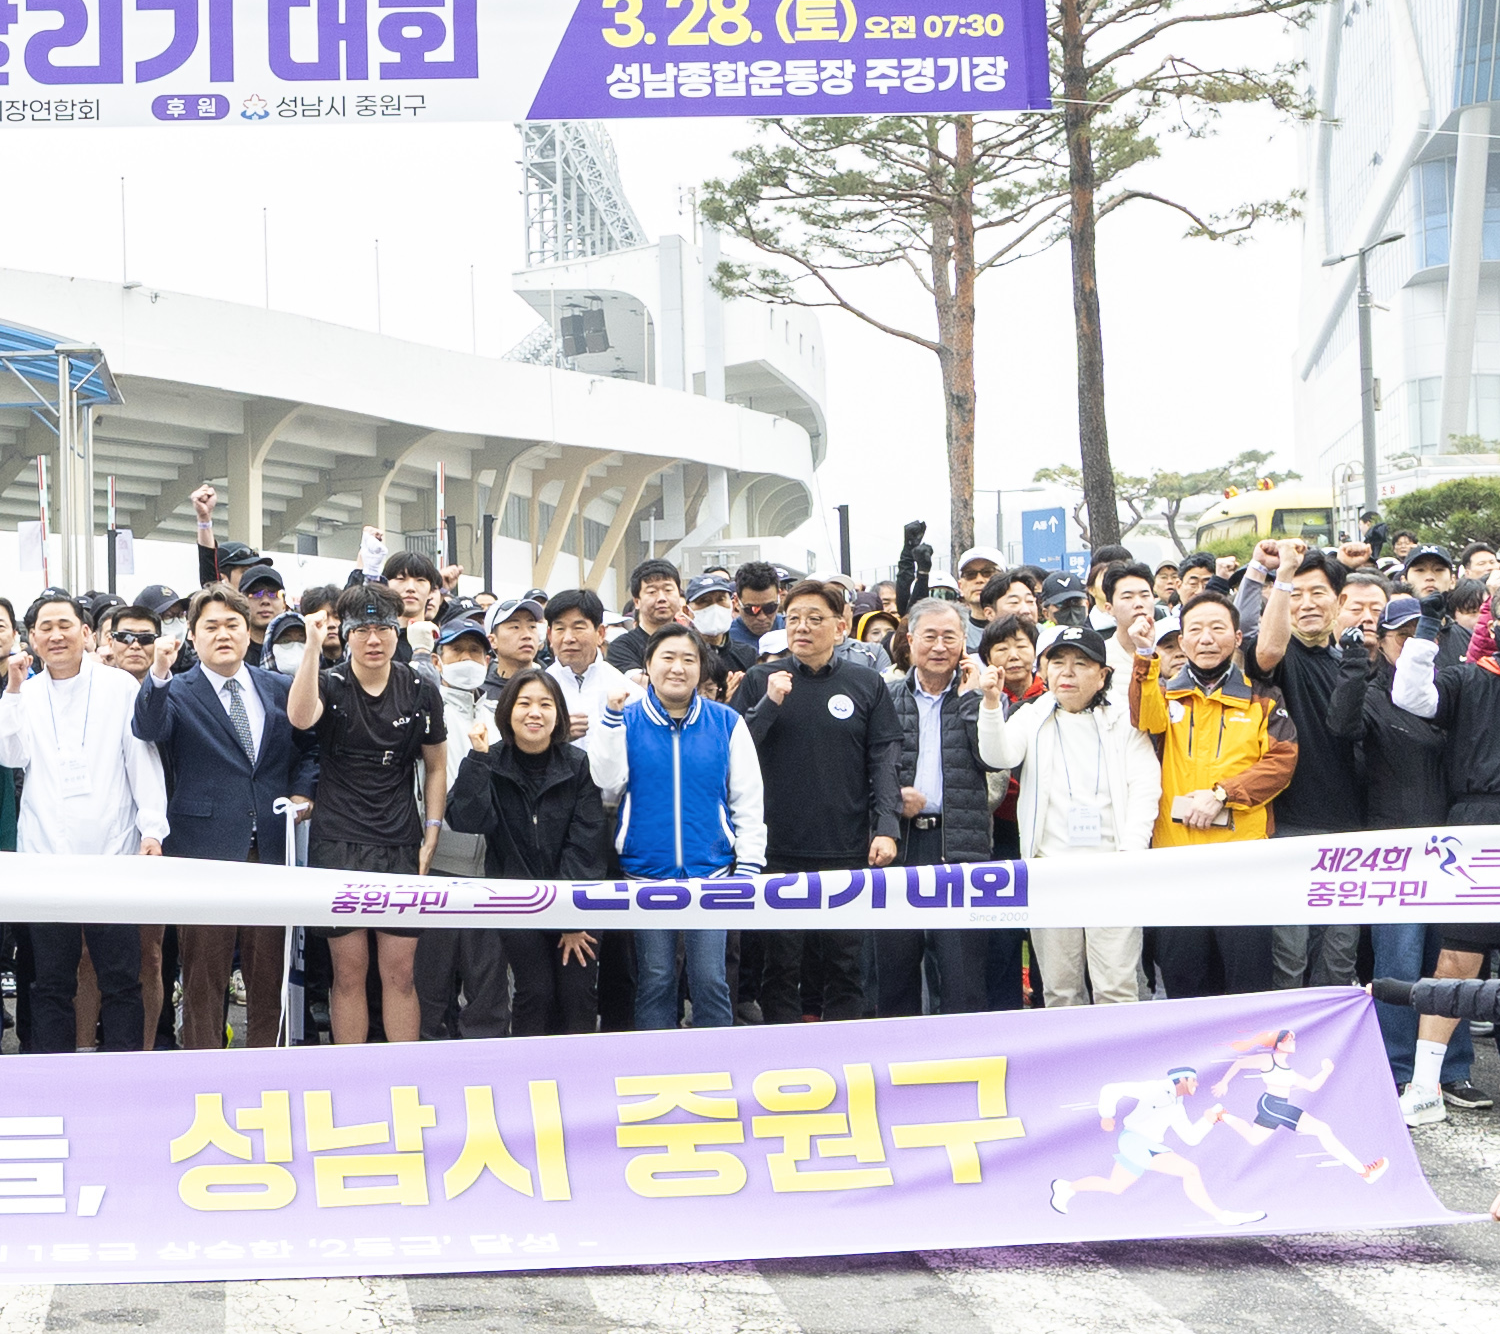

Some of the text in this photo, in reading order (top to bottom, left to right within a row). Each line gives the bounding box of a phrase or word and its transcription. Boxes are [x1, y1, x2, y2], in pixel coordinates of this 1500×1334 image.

[863, 17, 917, 41] 오전
[923, 13, 1005, 39] 07:30
[605, 55, 1009, 99] 성남종합운동장 주경기장
[274, 93, 348, 119] 성남시
[355, 93, 428, 119] 중원구
[1310, 845, 1410, 874] 제24회
[330, 888, 449, 916] 중원구민
[1306, 879, 1428, 908] 중원구민
[968, 911, 1029, 923] Since 2000
[169, 1078, 573, 1212] 성남시
[613, 1055, 1027, 1200] 중원구
[26, 1242, 139, 1263] 1등급
[156, 1239, 294, 1261] 상승한
[469, 1232, 561, 1255] 달성
